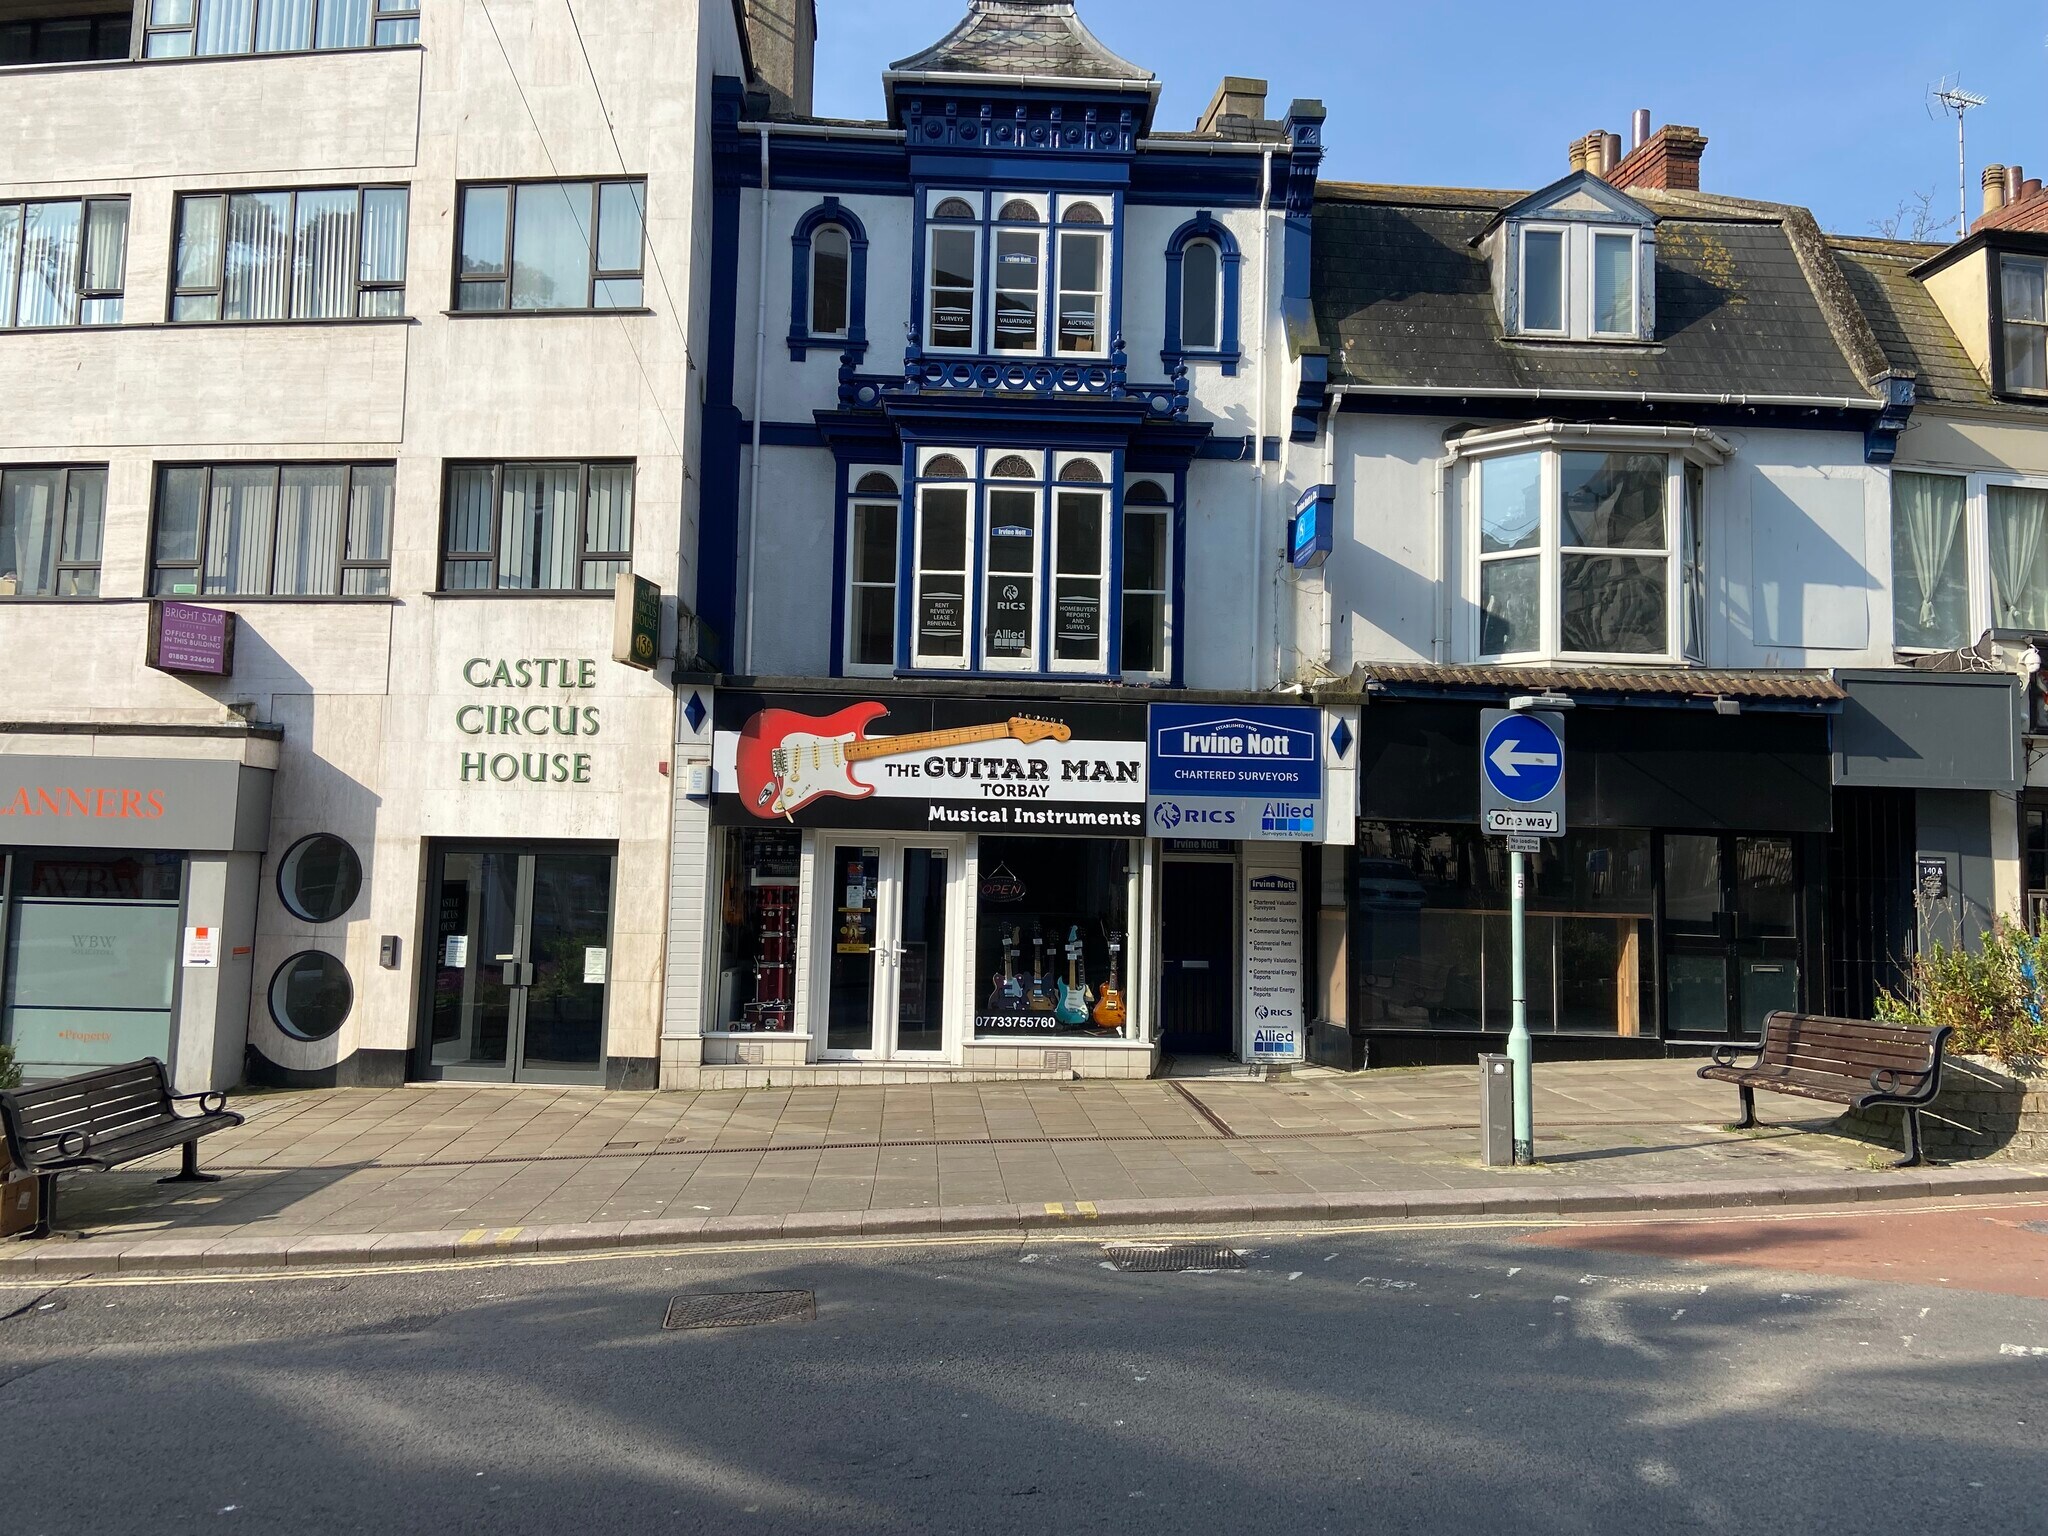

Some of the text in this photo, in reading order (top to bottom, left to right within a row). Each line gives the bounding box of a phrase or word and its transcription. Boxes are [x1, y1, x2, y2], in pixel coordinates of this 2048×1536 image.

[636, 600, 657, 618] CIRCUS
[997, 602, 1026, 610] RICS
[165, 607, 223, 624] BRIGHT STAR
[635, 612, 656, 630] HOUSE
[165, 630, 194, 639] OFFICES
[994, 629, 1025, 638] Allied
[190, 639, 220, 649] BUILDING
[638, 636, 651, 654] 136
[463, 658, 596, 688] CASTLE
[456, 705, 600, 735] CIRCUS
[1183, 731, 1290, 755] Irvine Nott
[459, 752, 591, 783] HOUSE
[885, 756, 1141, 783] THE GUITAR MAN
[1175, 770, 1299, 782] CHARTERED SURVEYORS
[981, 783, 1050, 798] TORBAY
[928, 806, 1141, 825] Musical Instruments
[1185, 810, 1235, 823] RICS
[1263, 802, 1313, 818] Allied
[1526, 818, 1552, 829] way
[1174, 839, 1219, 849] Irvine Nott
[982, 884, 1021, 894] OPEN
[1518, 880, 1523, 888] 5
[72, 935, 116, 948] WBW
[976, 1016, 1055, 1028] 07733755760
[1255, 1030, 1294, 1042] Allied
